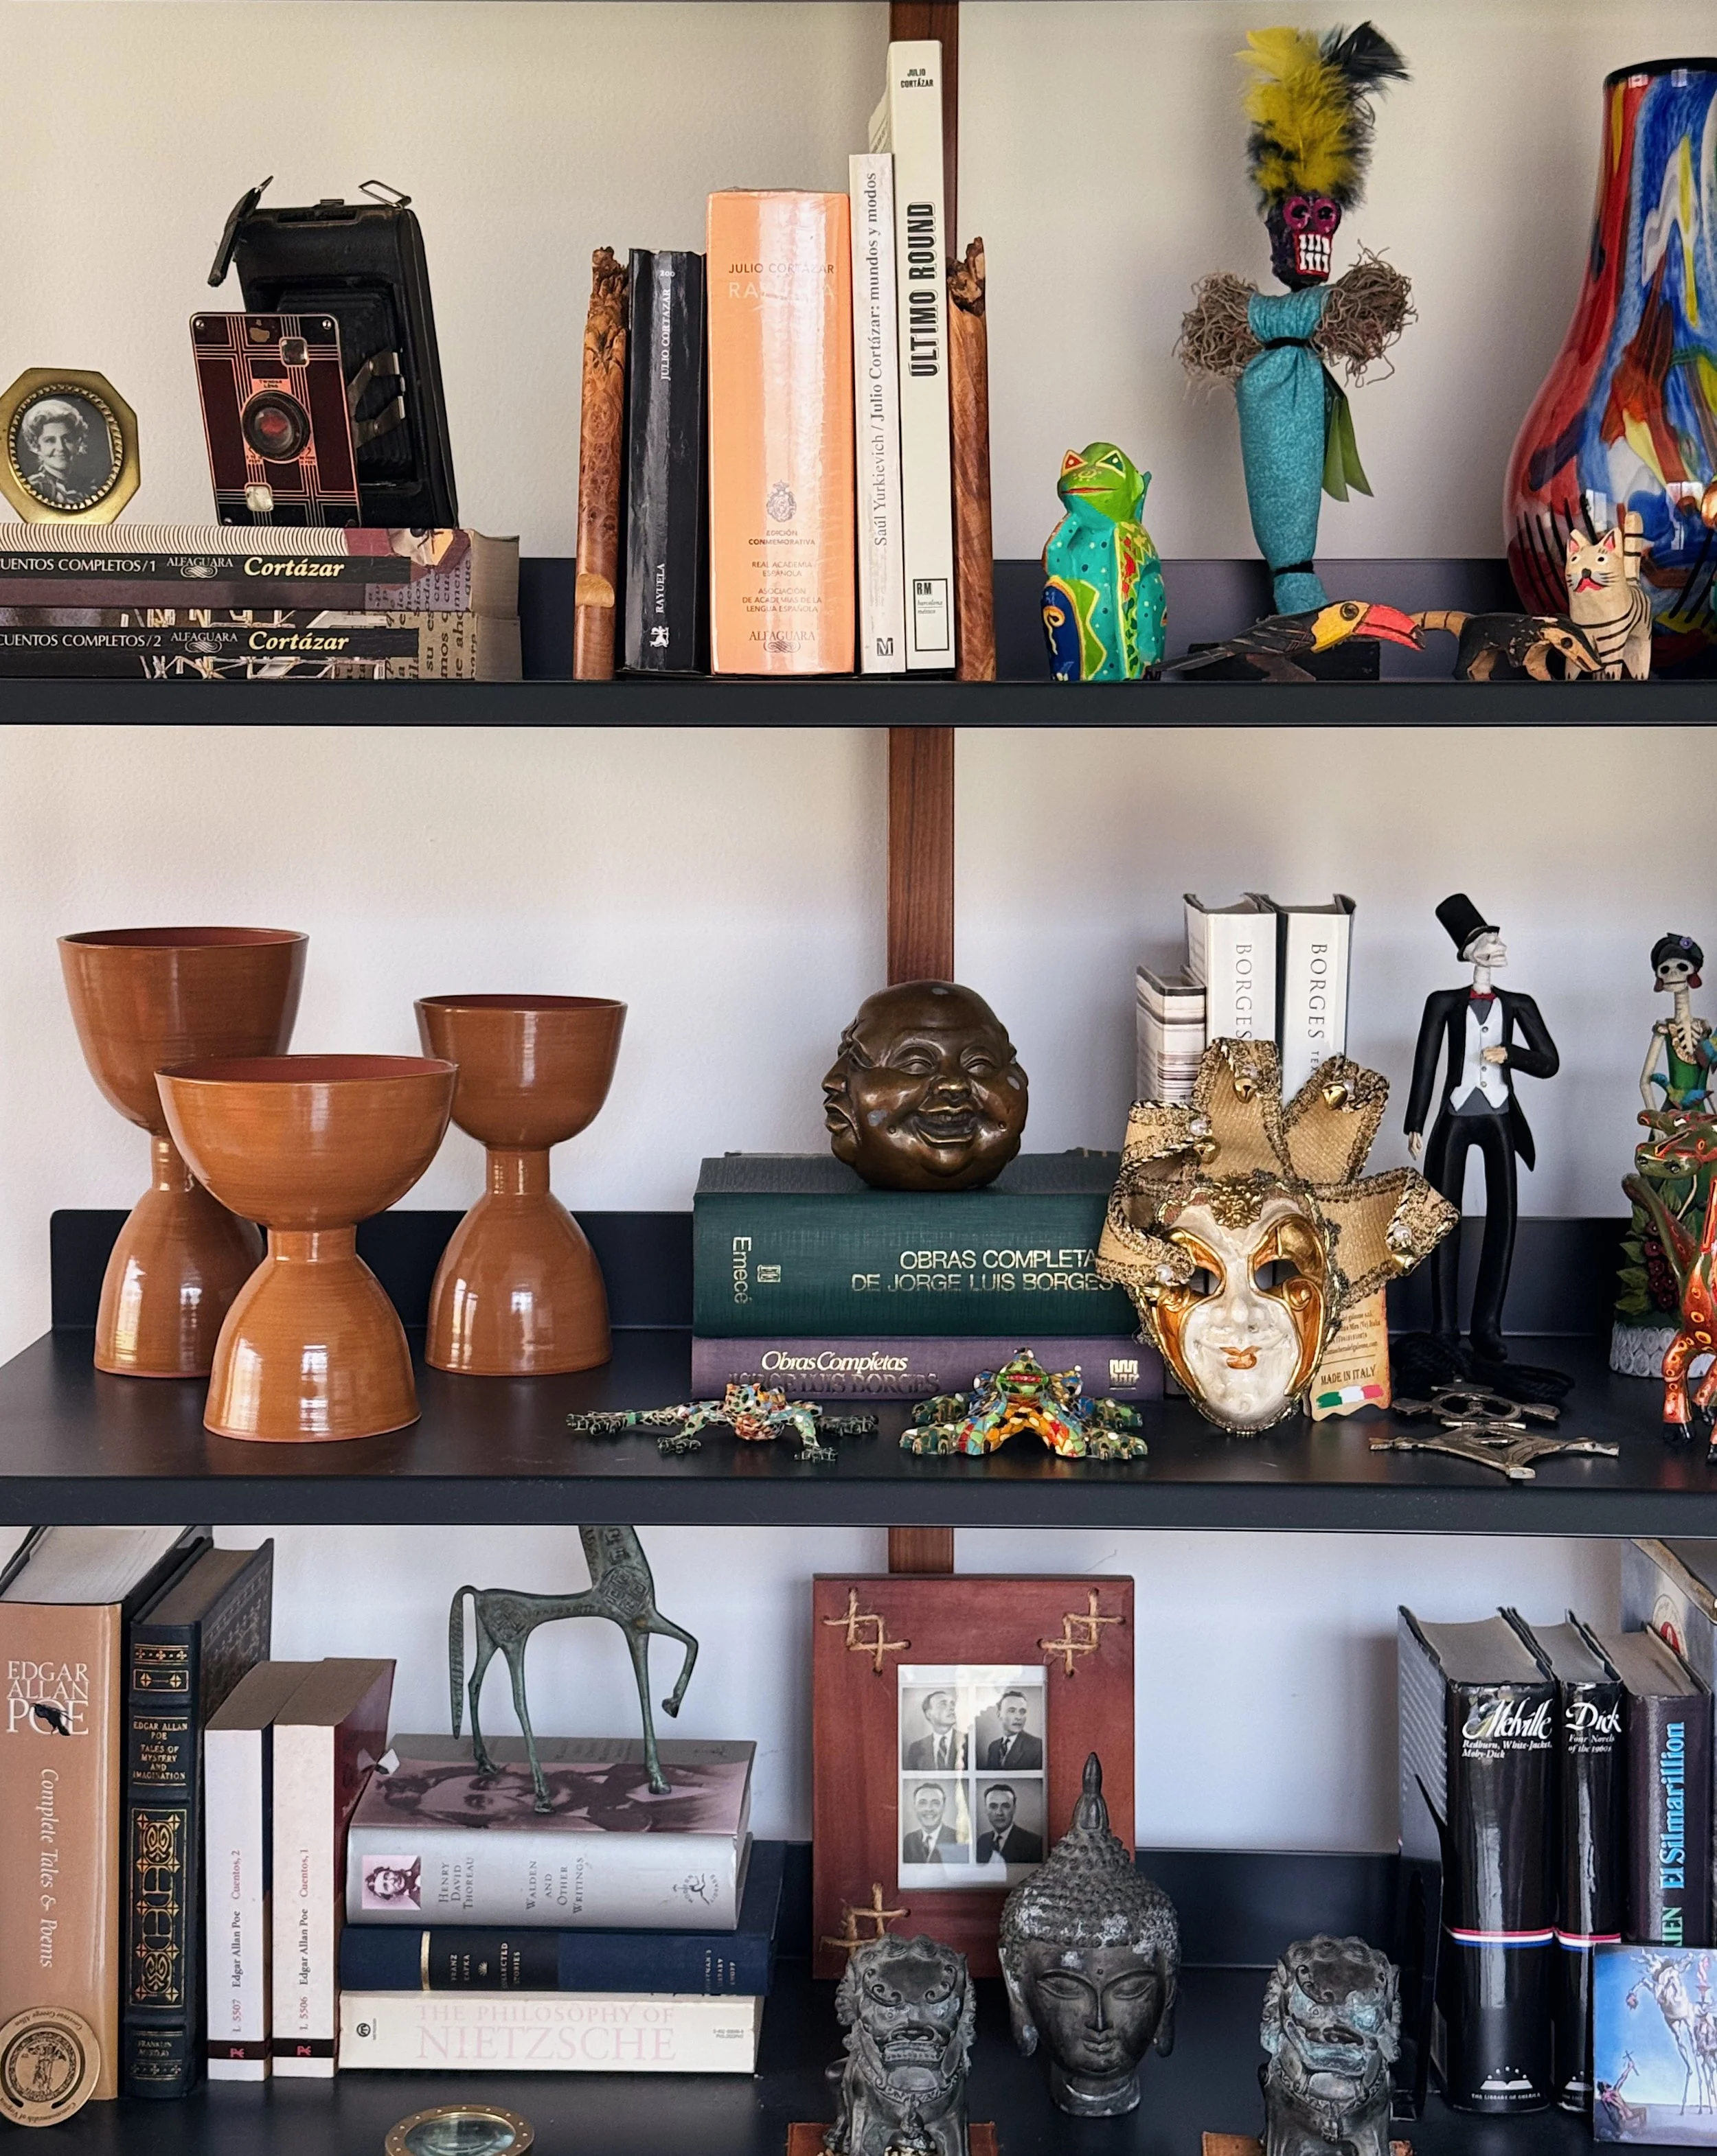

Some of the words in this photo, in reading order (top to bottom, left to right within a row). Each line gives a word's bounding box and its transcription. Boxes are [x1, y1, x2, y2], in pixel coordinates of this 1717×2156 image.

[900, 78, 934, 88] CORTÁZAR
[907, 69, 926, 77] JULIO
[865, 172, 877, 222] modos
[869, 225, 881, 236] y
[907, 201, 936, 280] ROUND
[729, 263, 764, 273] JULIO
[769, 260, 834, 273] CORTÁZAR
[867, 239, 880, 300] mundos
[868, 306, 883, 380] Cortázar:
[660, 349, 671, 380] JULIO
[870, 385, 885, 421] Julio
[873, 435, 887, 514] Yurkievich
[874, 516, 887, 546] Saúl
[0, 558, 54, 571] UENTOS
[58, 558, 157, 572] COMPLETOS/1
[167, 558, 234, 567] ALFAGUARA
[244, 556, 345, 577] Cortázar
[655, 563, 666, 614] RAYUELA
[916, 582, 932, 595] RM
[62, 634, 162, 647] COMPLETOS/2
[171, 632, 238, 642] ALFAGUARA
[249, 631, 350, 652] Cortázar
[749, 631, 815, 641] ALFAGUARA
[1236, 944, 1252, 1039] BORGES
[1308, 944, 1328, 1038] BORGES
[733, 1237, 752, 1304] Emecé
[900, 1250, 977, 1269] OBRAS
[983, 1249, 1097, 1268] COMPLETA
[852, 1274, 880, 1292] DE
[888, 1274, 962, 1292] JORGE
[970, 1274, 1015, 1291] LUIS
[1023, 1273, 1114, 1291] BORGES
[762, 1351, 815, 1371] Obras
[817, 1351, 909, 1373] Completas
[799, 1373, 846, 1393] LUIS
[851, 1373, 941, 1394] BORGES
[1321, 1372, 1341, 1386] MADE
[1343, 1370, 1351, 1380] IN
[1352, 1364, 1376, 1379] ITALY
[8, 1660, 89, 1681] EDGAR
[7, 1679, 89, 1699] ALLAN
[6, 1697, 89, 1735] POE
[133, 1721, 159, 1730] EDGAR
[1462, 1696, 1554, 1740] Melville
[1565, 1694, 1622, 1734] Dick
[151, 1732, 168, 1740] POE
[1462, 1740, 1500, 1750] Redburn,
[1569, 1734, 1588, 1743] Four
[141, 1744, 165, 1753] TALES
[168, 1745, 179, 1754] OF
[141, 1754, 177, 1762] MYSTERY
[1462, 1750, 1505, 1760] Moby-Dick
[1568, 1745, 1578, 1754] of
[1659, 1721, 1685, 1866] Silmarillion
[36, 1769, 59, 1843] Complete
[41, 1849, 59, 1888] Tales
[231, 1857, 242, 1900] Cuentos,
[299, 1855, 310, 1898] Cuentos,
[1659, 1866, 1685, 1889] El
[438, 1862, 450, 1903] HENRY
[451, 1865, 462, 1901] DAVID
[463, 1857, 475, 1910] THOREAU
[525, 1860, 537, 1910] WALDEN
[557, 1866, 568, 1905] OTHER
[573, 1857, 584, 1914] WRITINGS
[41, 1894, 56, 1911] &
[232, 1911, 240, 1925] Poe
[299, 1909, 308, 1925] Poe
[41, 1918, 58, 1968] Poems
[232, 1931, 240, 1956] Allan
[299, 1929, 308, 1955] Allan
[231, 1958, 243, 1988] Edgar
[299, 1956, 311, 1986] Edgar
[232, 1999, 241, 2021] 5507
[299, 1996, 308, 2019] 5506
[418, 2004, 466, 2021] THE
[478, 2004, 635, 2023] PHILOSOPHY
[643, 2006, 674, 2023] OF
[415, 2025, 677, 2061] NIETZSCHE
